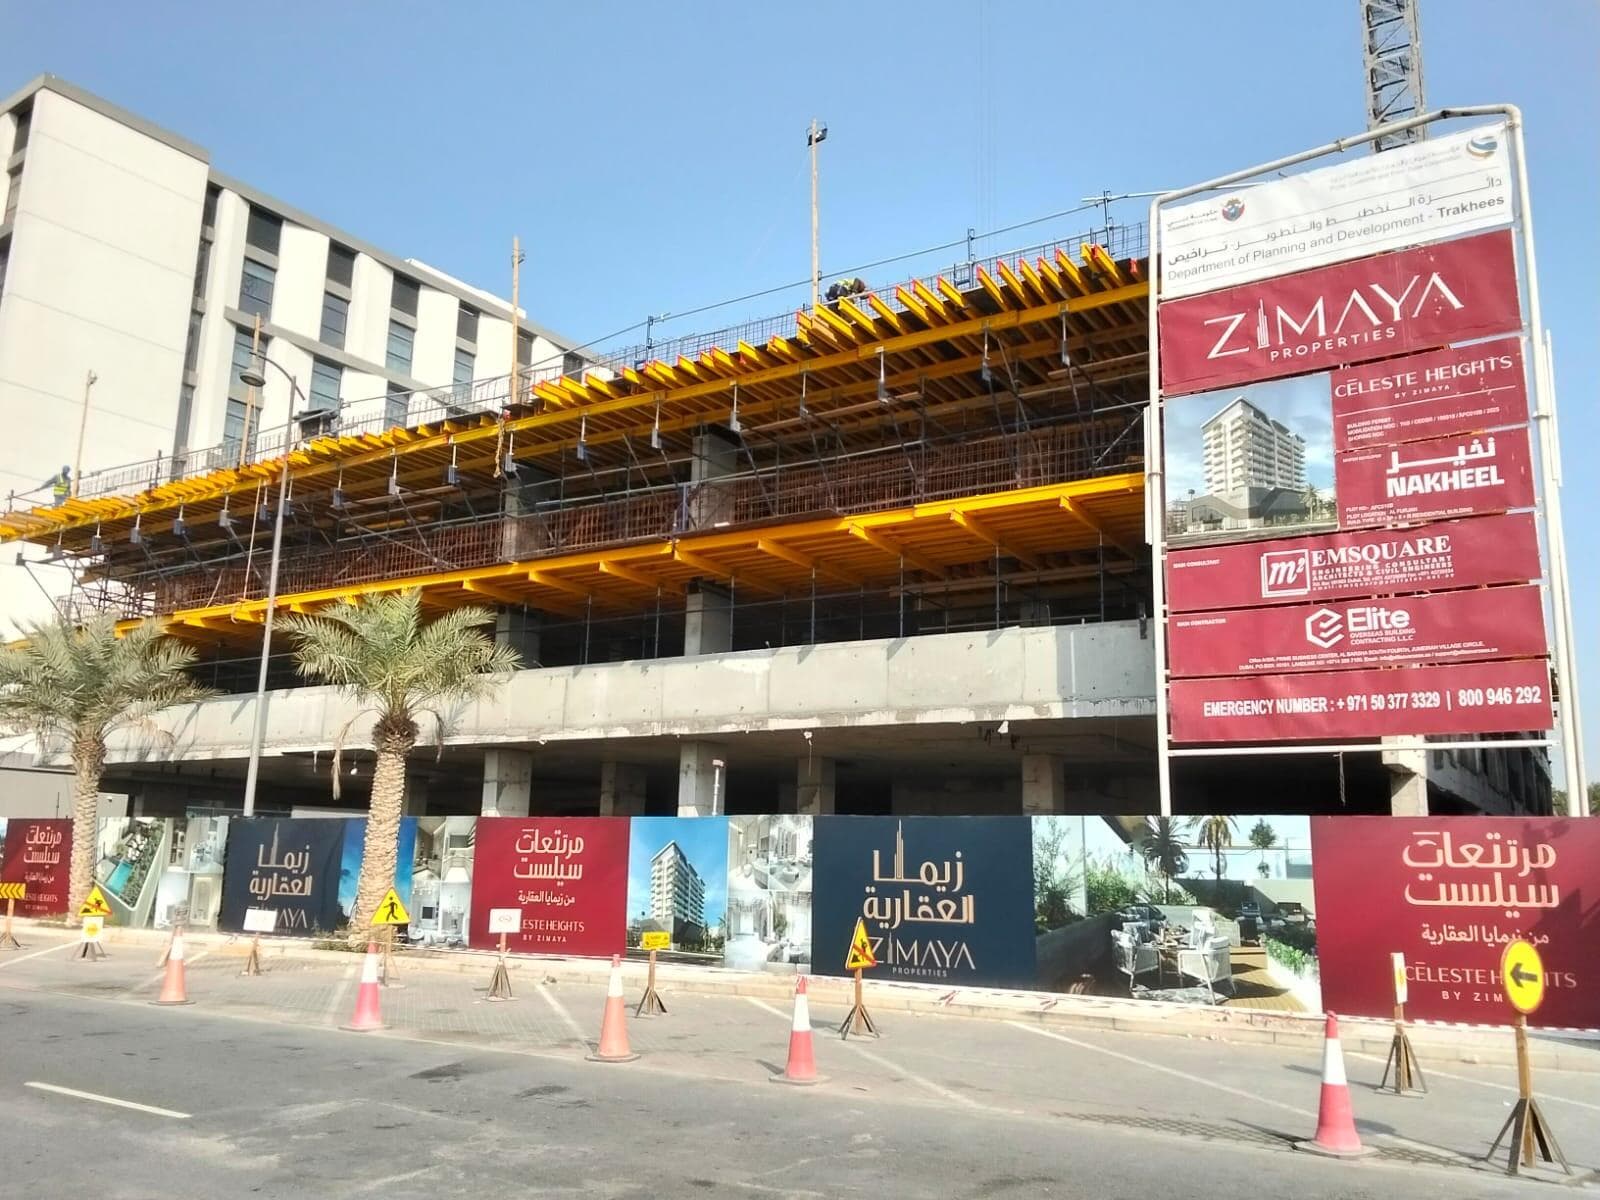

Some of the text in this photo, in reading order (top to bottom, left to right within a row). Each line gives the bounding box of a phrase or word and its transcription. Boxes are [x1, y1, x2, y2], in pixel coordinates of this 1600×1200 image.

[1168, 254, 1235, 280] Department
[1238, 251, 1250, 265] of
[1253, 241, 1306, 262] Planning
[1310, 233, 1333, 249] and
[1337, 213, 1424, 240] Development
[1437, 195, 1505, 220] Trakhees
[1204, 271, 1464, 359] ZIMAYA
[1270, 327, 1396, 362] PROPERTIES
[1425, 355, 1513, 383] HEIGHTS
[1394, 384, 1450, 399] BY ZIMAYA
[1386, 465, 1504, 498] NAKHEEL
[1312, 535, 1452, 567] EMSQUARE
[1385, 555, 1452, 568] CONSULTANT
[1376, 567, 1400, 575] CIVIL
[1347, 607, 1410, 632] Elite
[1350, 636, 1396, 645] CONTRACTING
[1203, 699, 1273, 718] EMERGENCY
[1276, 697, 1328, 715] NUMBER
[1347, 695, 1367, 712] 971
[1371, 694, 1385, 711] 50
[1387, 693, 1409, 710] 377
[1411, 692, 1440, 709] 3329
[1458, 689, 1483, 707] 800
[1486, 688, 1512, 706] 946
[1515, 686, 1541, 705] 292
[249, 870, 313, 901] العقارية
[1404, 872, 1560, 918] سيلست
[863, 886, 974, 929] العقارية
[545, 919, 585, 932] HEIGHTS
[1421, 923, 1478, 945] العقارية
[893, 966, 948, 978] PROPERTIES
[1441, 990, 1461, 1000] BY
